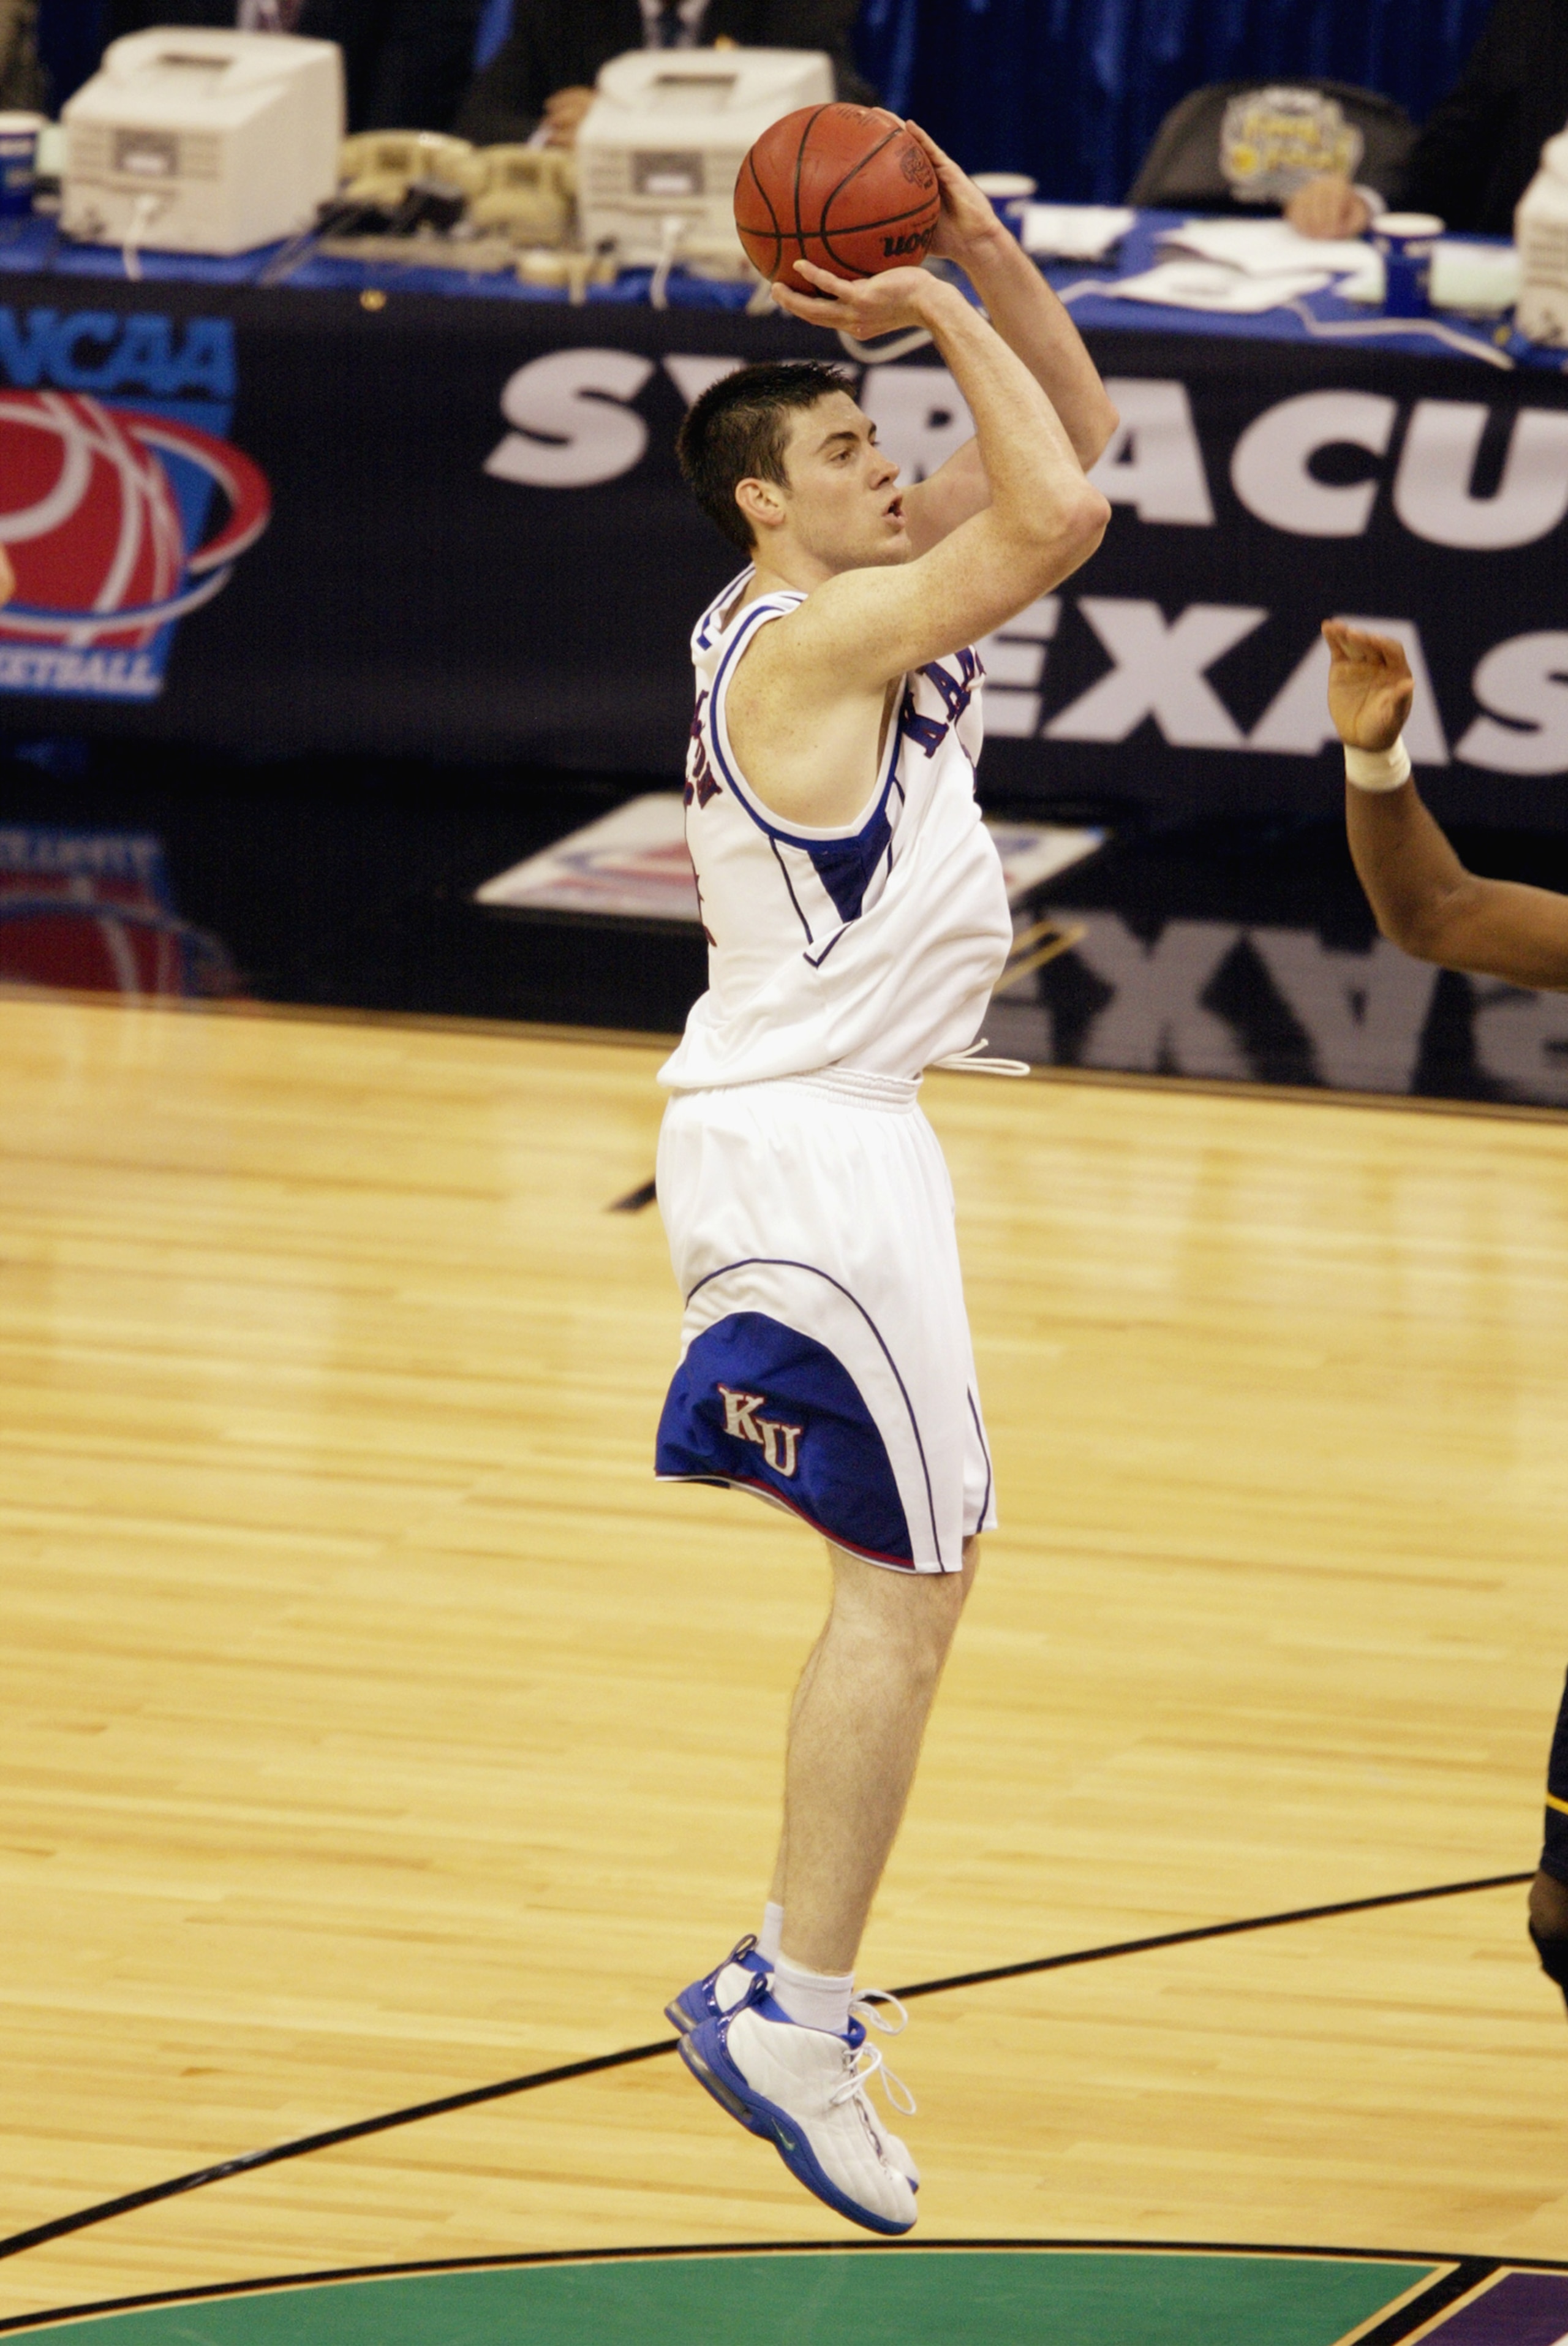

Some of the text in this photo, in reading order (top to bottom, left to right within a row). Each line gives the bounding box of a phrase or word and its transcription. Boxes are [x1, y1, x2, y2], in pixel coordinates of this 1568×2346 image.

[484, 347, 1568, 551] SRACU
[974, 593, 1568, 777] EXAS
[717, 1383, 801, 1478] KU
